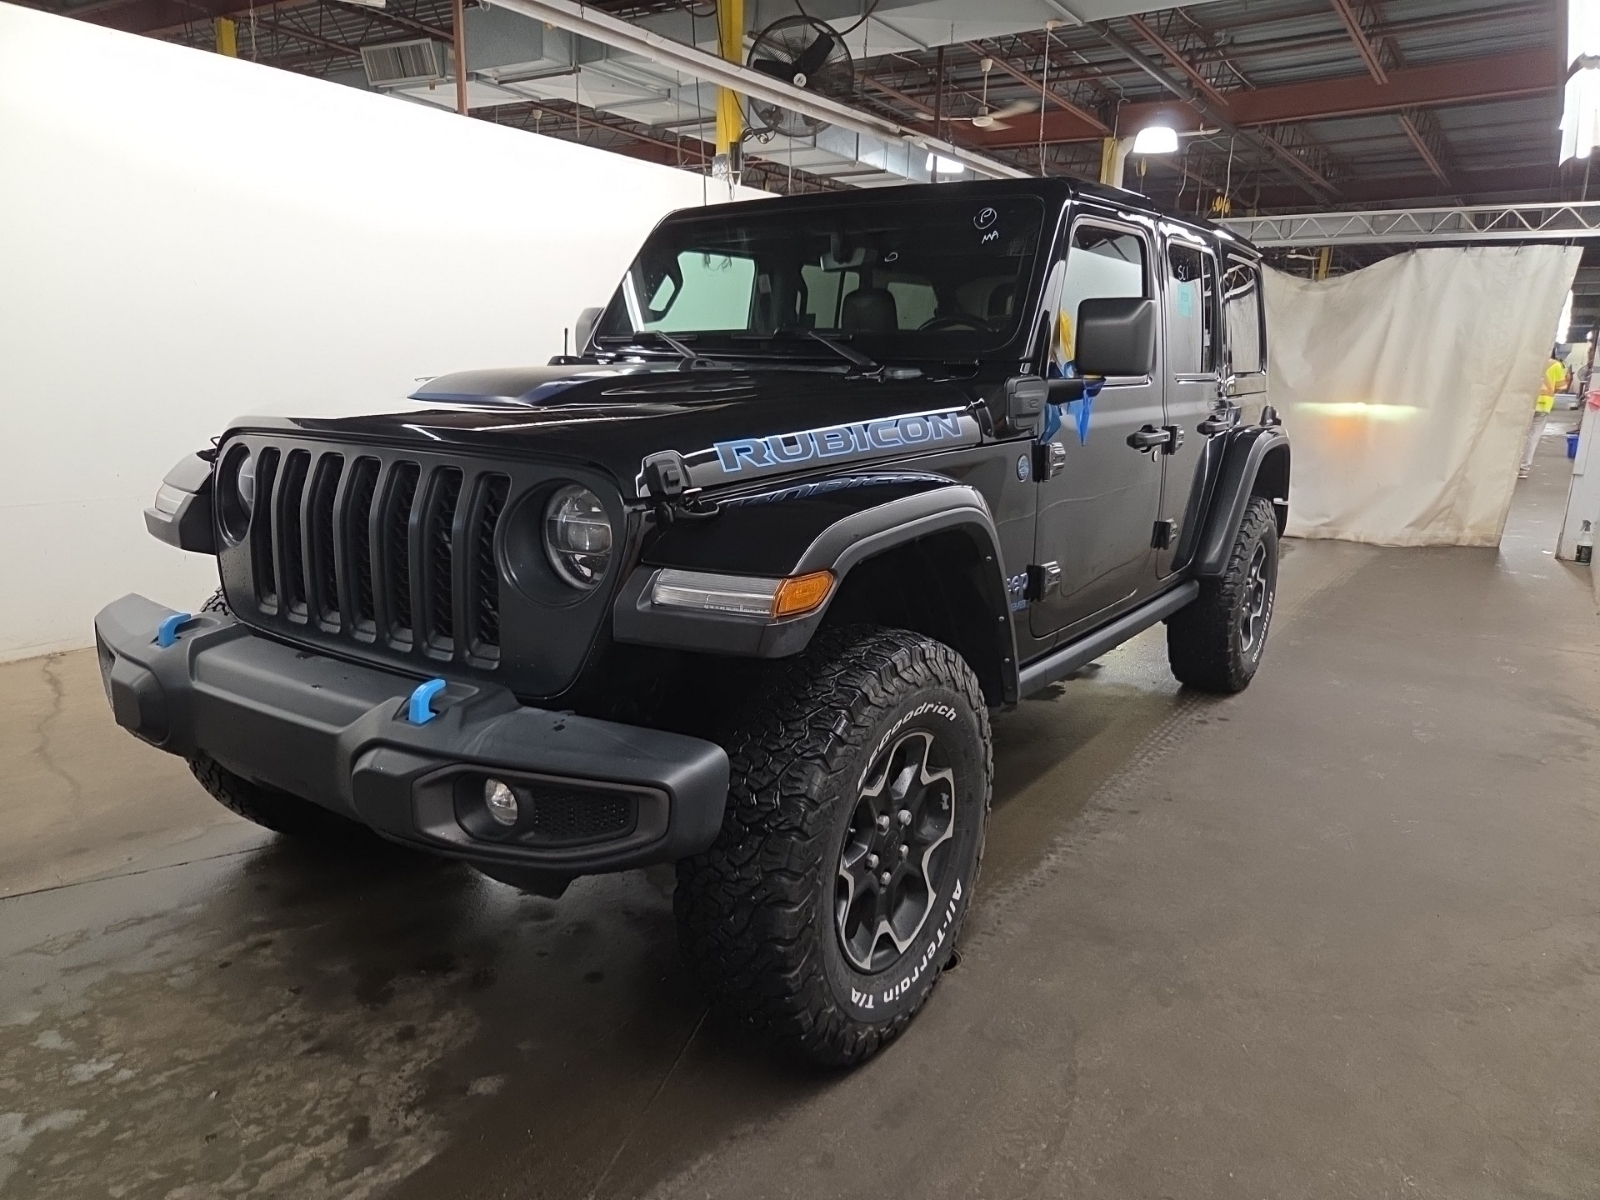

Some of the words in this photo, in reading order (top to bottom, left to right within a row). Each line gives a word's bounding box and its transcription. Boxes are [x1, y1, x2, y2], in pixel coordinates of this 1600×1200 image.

[713, 412, 962, 473] RUBICON
[883, 878, 962, 1003] All-Terrain
[851, 987, 875, 1009] T/A
